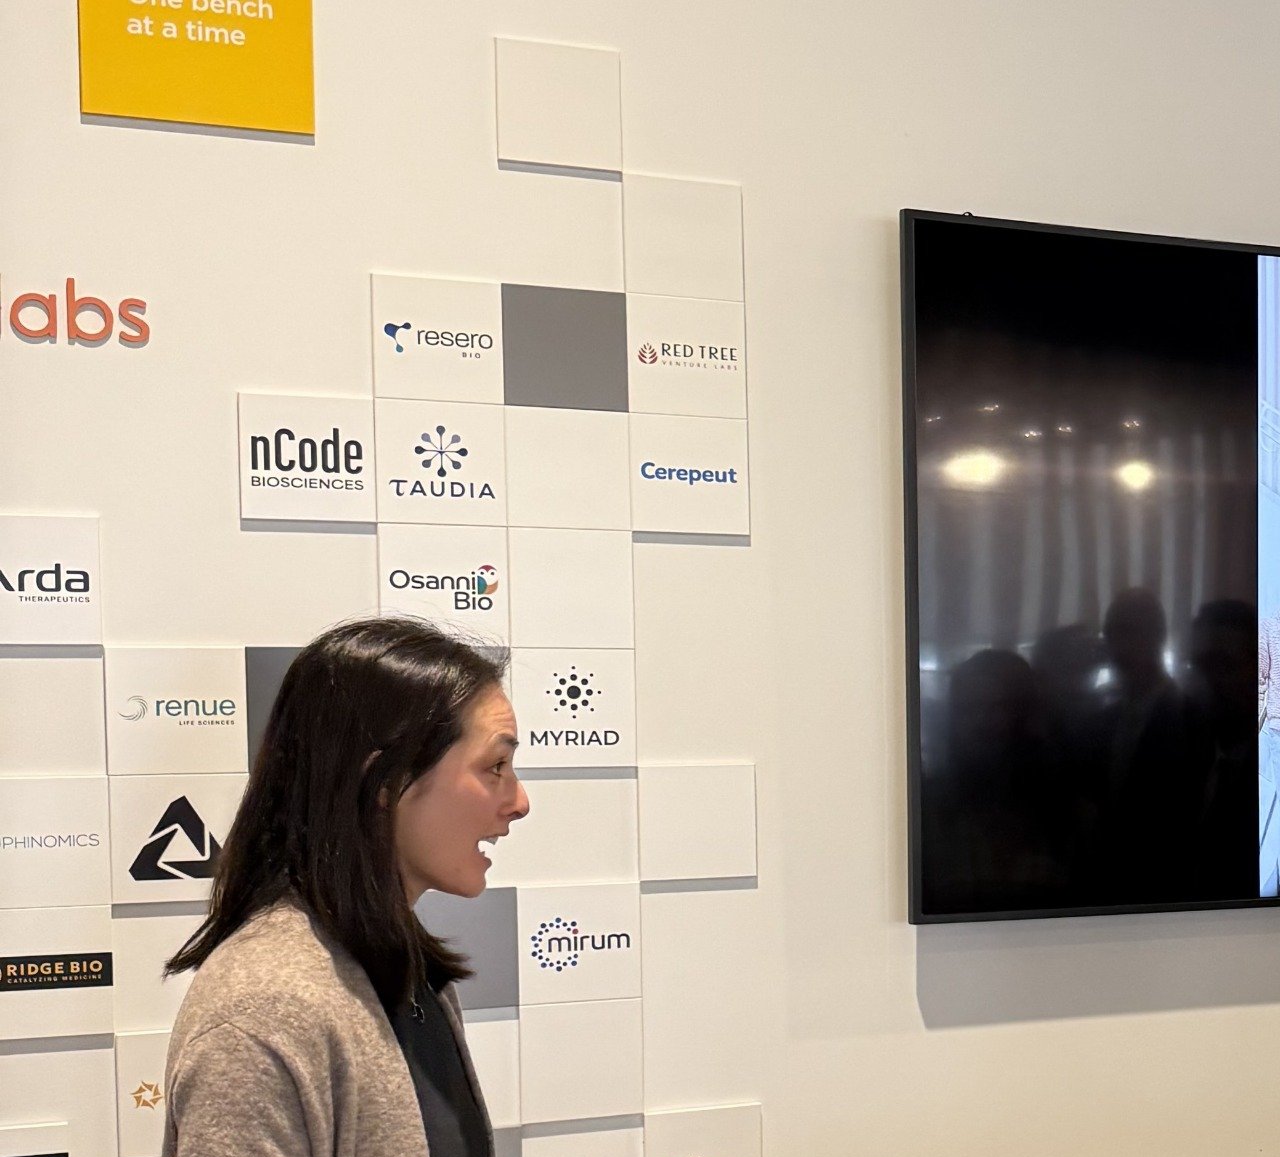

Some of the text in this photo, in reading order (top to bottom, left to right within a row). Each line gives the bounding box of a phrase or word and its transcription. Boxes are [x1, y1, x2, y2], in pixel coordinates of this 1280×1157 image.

[192, 0, 274, 20] bench
[126, 15, 246, 46] at a time
[0, 277, 150, 347] abs
[416, 329, 493, 350] resero
[461, 351, 481, 359] BIO
[661, 342, 738, 361] RED TREE
[250, 427, 363, 475] nCode
[251, 476, 364, 490] BIOSCIENCES
[640, 461, 738, 486] Cerepeut
[389, 569, 476, 590] Osanni
[18, 595, 91, 603] THERAPEUTICS
[454, 590, 494, 611] Bio
[155, 699, 236, 717] renue
[530, 730, 620, 747] MYRIAD
[0, 833, 100, 850] PHINOMICS
[548, 928, 631, 953] mirum
[6, 960, 103, 977] RIDGE BIO
